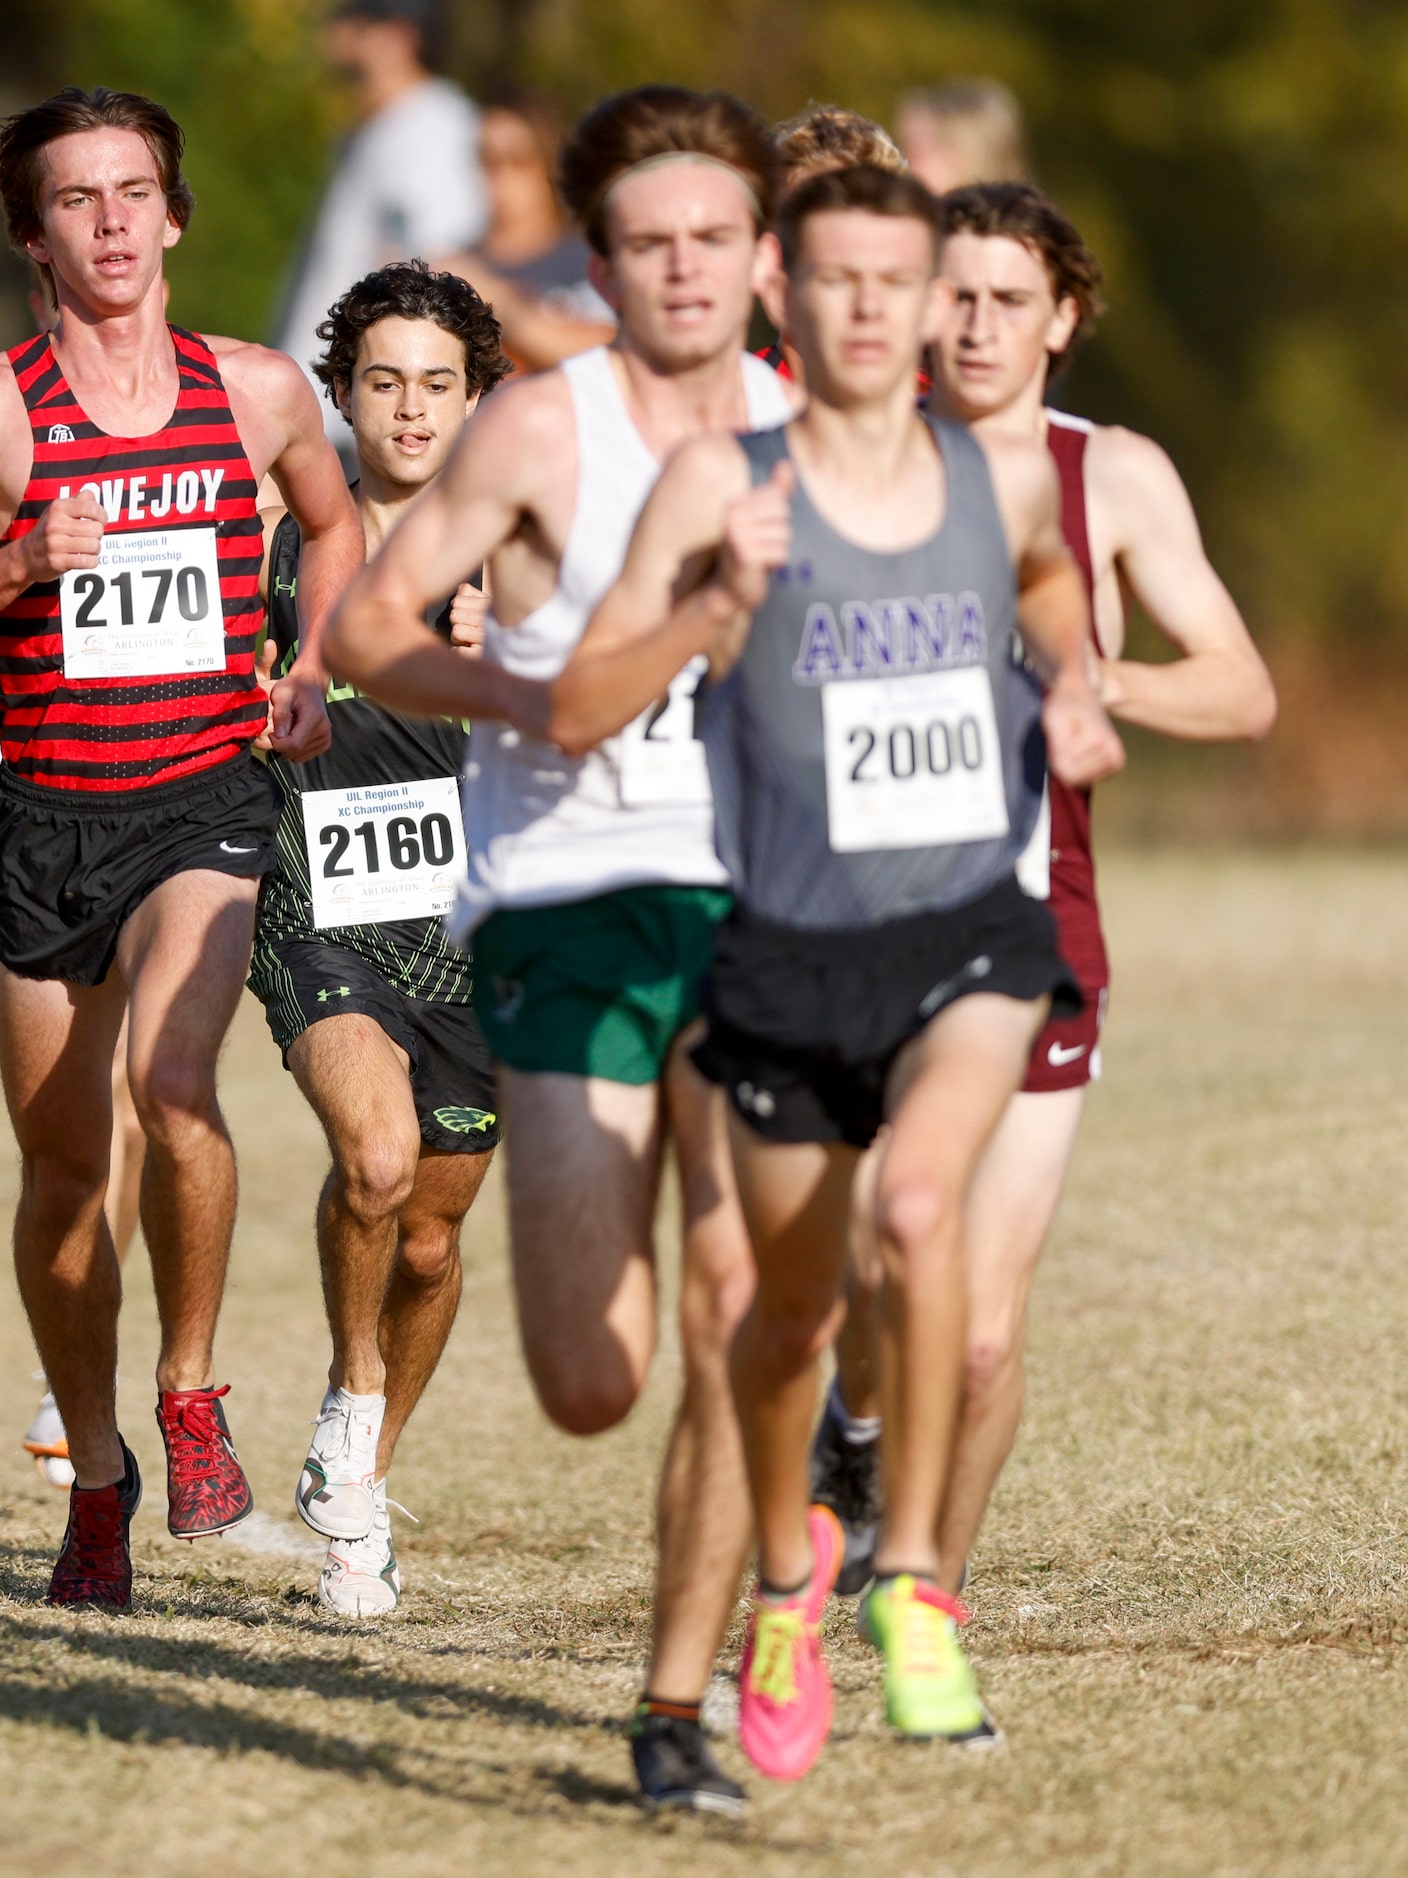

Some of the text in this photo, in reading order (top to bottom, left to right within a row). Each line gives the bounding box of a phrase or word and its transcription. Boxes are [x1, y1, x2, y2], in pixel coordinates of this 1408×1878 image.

[59, 468, 225, 523] VEJOY
[105, 539, 121, 550] UIL
[124, 537, 158, 549] Region
[111, 551, 182, 564] Championship
[73, 566, 209, 628] 2170
[114, 638, 174, 649] ARLINGTON
[793, 590, 988, 687] ANNA
[197, 657, 214, 666] 2170
[847, 713, 983, 783] 2000
[346, 786, 409, 802] UIL Region II
[338, 800, 425, 817] XC Championship
[319, 812, 454, 879] 2160
[361, 883, 420, 897] ARLINGTON
[432, 902, 443, 910] No.
